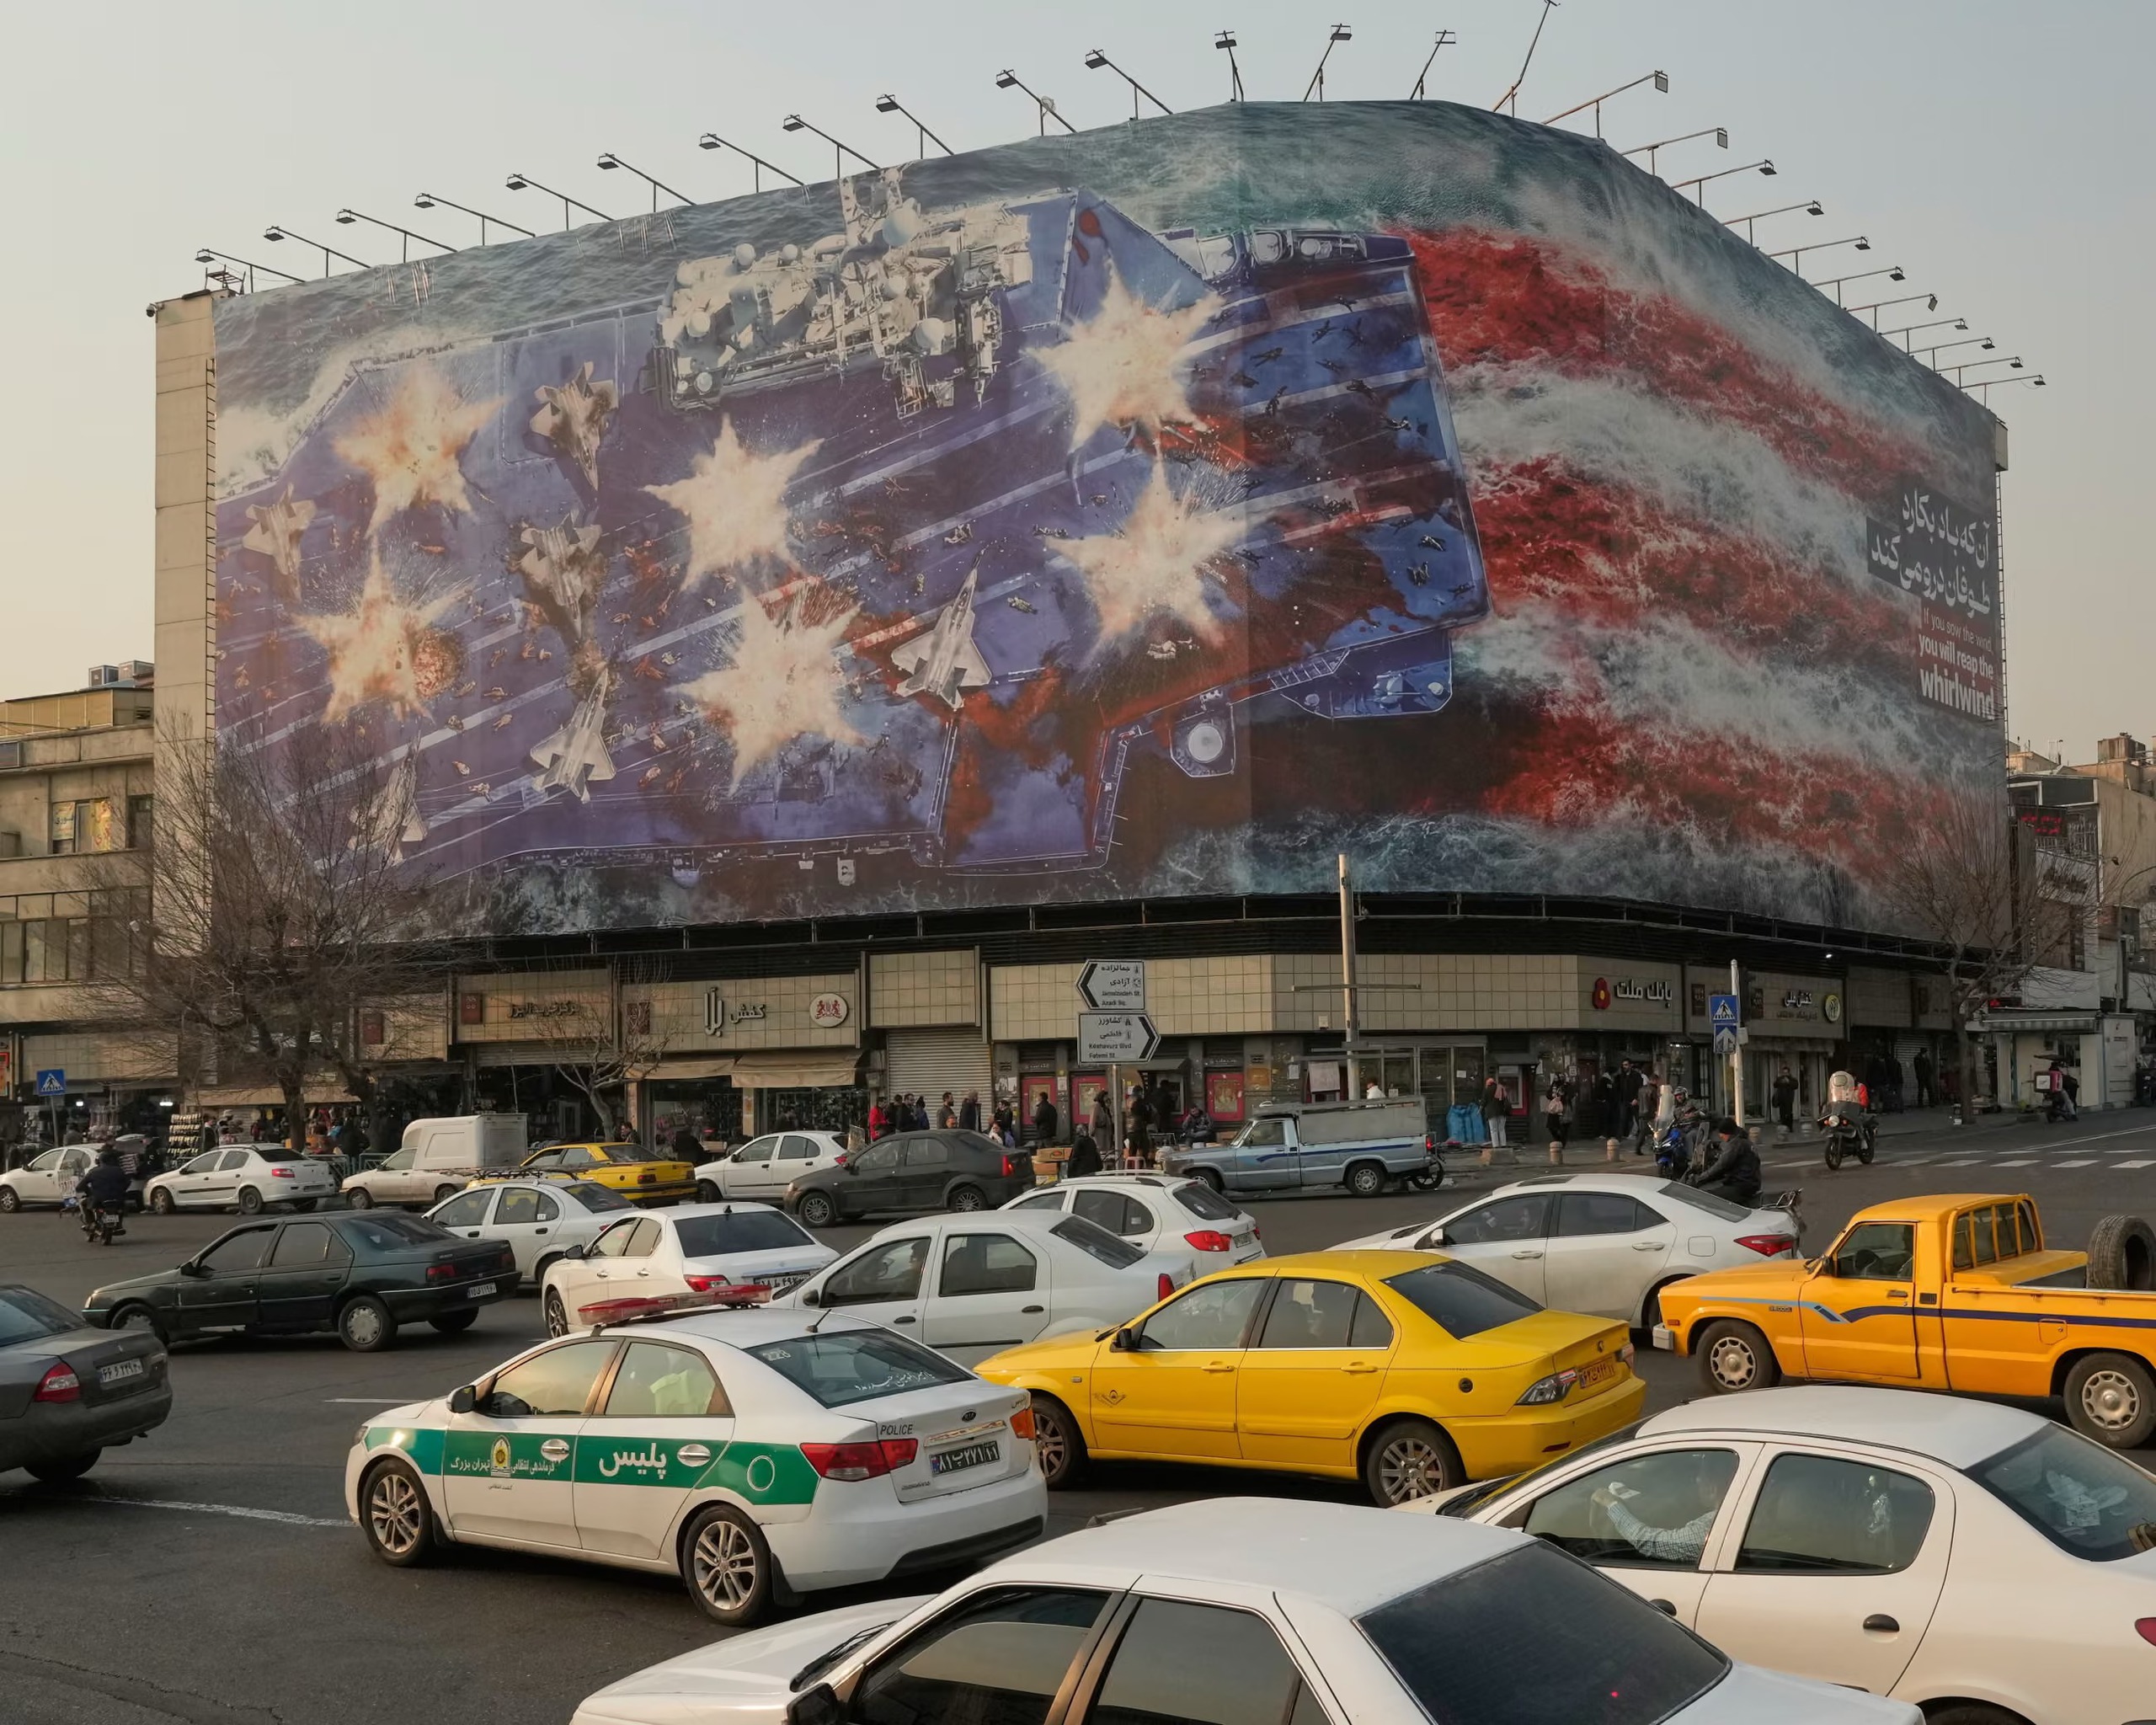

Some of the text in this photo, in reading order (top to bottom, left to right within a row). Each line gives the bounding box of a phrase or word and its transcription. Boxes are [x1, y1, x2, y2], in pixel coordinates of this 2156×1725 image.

[1902, 488, 1935, 544] بکارد
[1938, 506, 1959, 557] باد
[1945, 565, 1990, 618] طوفان
[1924, 607, 1929, 624] If
[1931, 616, 1945, 631] you
[1946, 622, 1961, 638] sow
[1963, 626, 1974, 644] the
[1919, 633, 1993, 680] you will reap the
[1920, 664, 1995, 720] whirlwind
[1109, 978, 1130, 986] آزادی
[1617, 979, 1643, 999] ملت
[1784, 990, 1812, 1008] کفش ملی
[729, 1003, 766, 1024] کفش
[1098, 1017, 1122, 1025] کشاورز
[880, 1424, 913, 1435] POLICE
[451, 1457, 471, 1471] بزرگ
[472, 1458, 490, 1471] تهران
[510, 1459, 530, 1473] انتظامی
[599, 1443, 667, 1479] پلیس
